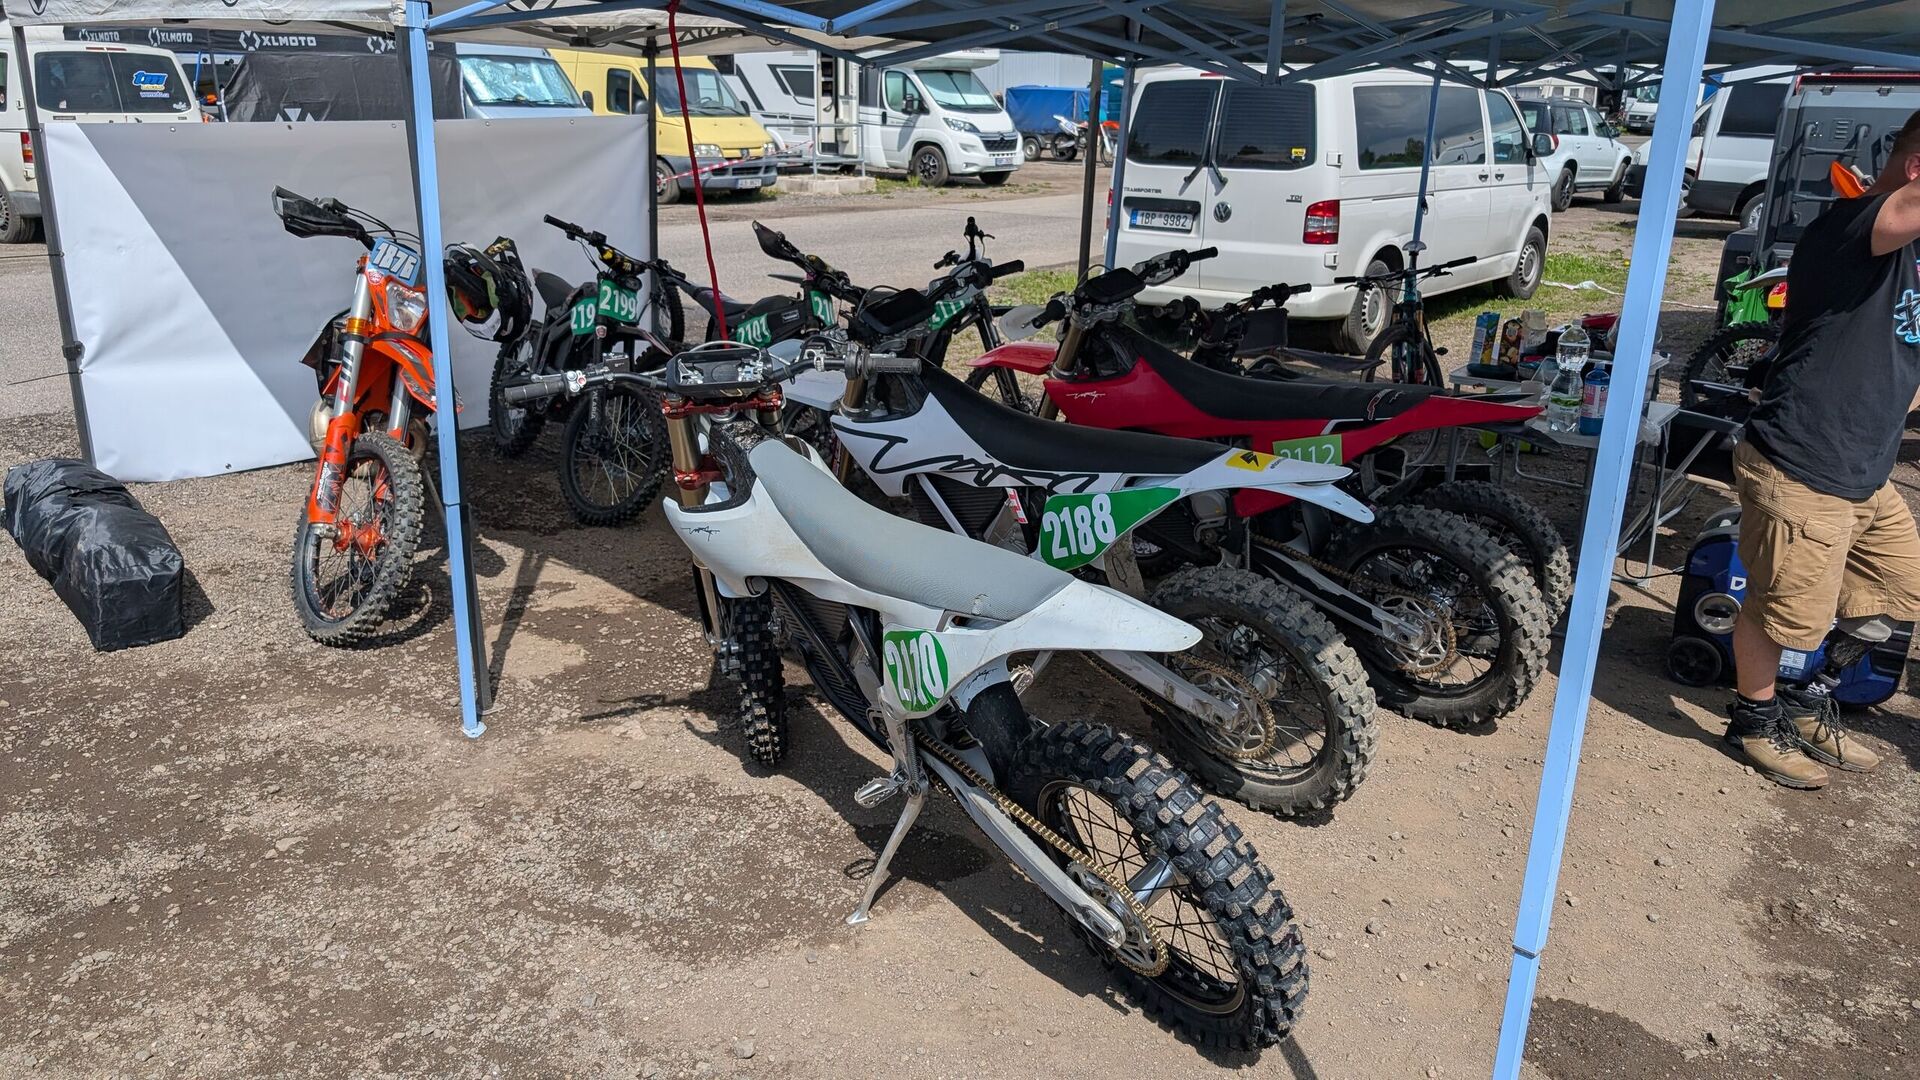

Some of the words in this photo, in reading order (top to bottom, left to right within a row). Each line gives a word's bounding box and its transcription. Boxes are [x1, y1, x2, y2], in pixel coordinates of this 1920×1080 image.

[89, 31, 120, 42] XLMOTO
[159, 31, 193, 43] XLMOTO
[262, 35, 317, 47] XLMOTO
[1123, 186, 1162, 194] TRANSPORTER
[1140, 212, 1157, 225] 1BP
[1163, 213, 1188, 228] 9982
[372, 241, 418, 280] 1876
[600, 285, 636, 320] 2199
[570, 303, 596, 330] 219
[1042, 493, 1117, 560] 2188
